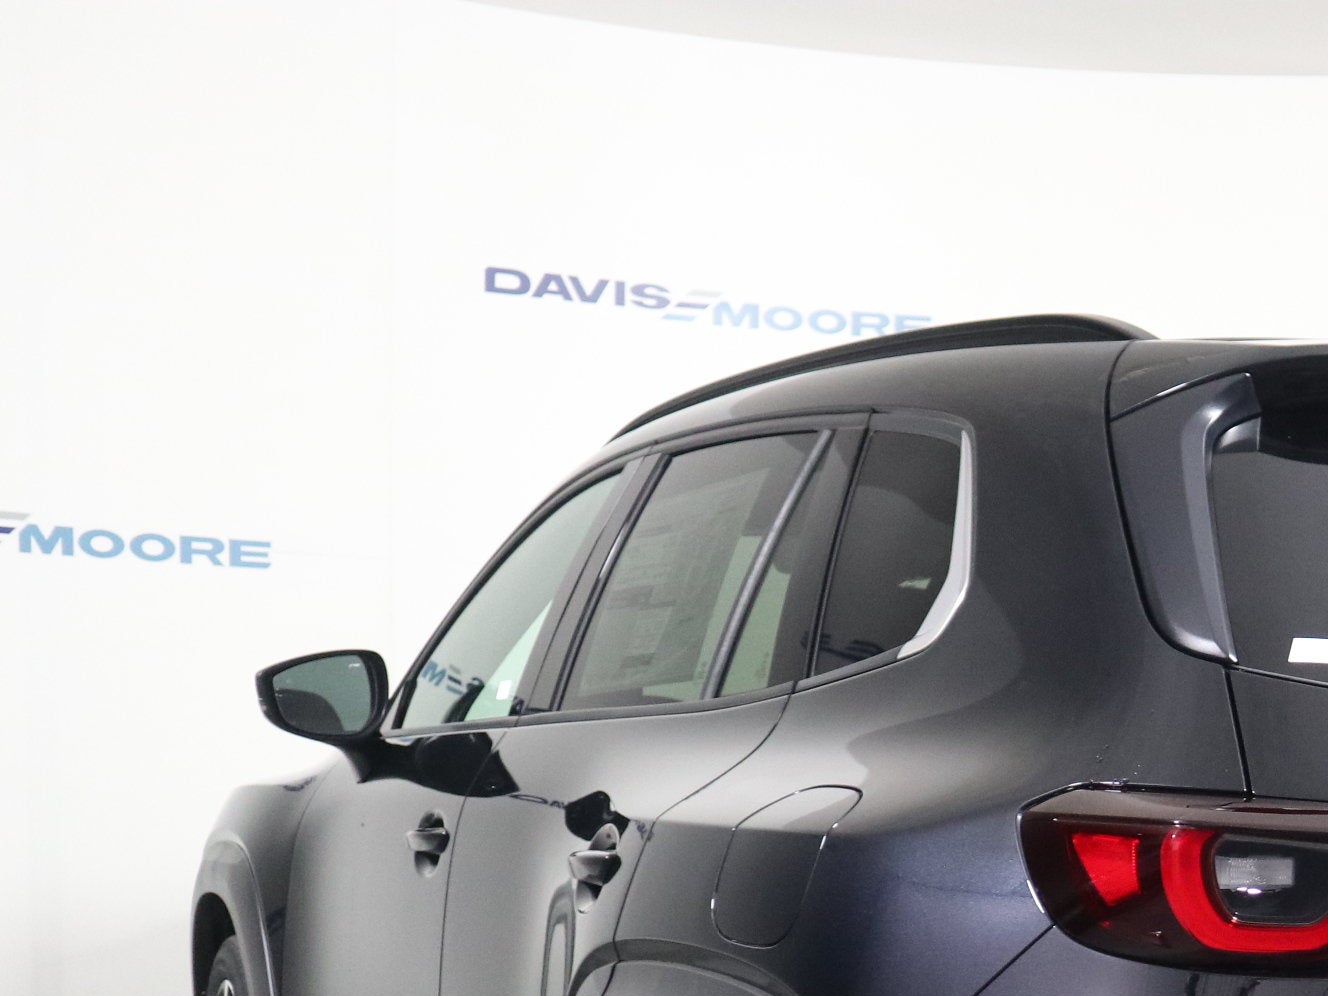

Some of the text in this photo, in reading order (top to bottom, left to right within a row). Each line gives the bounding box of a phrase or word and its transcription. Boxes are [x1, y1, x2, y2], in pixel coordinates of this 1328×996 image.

[484, 266, 933, 337] DAVIS MOORE
[18, 523, 272, 569] MOORE
